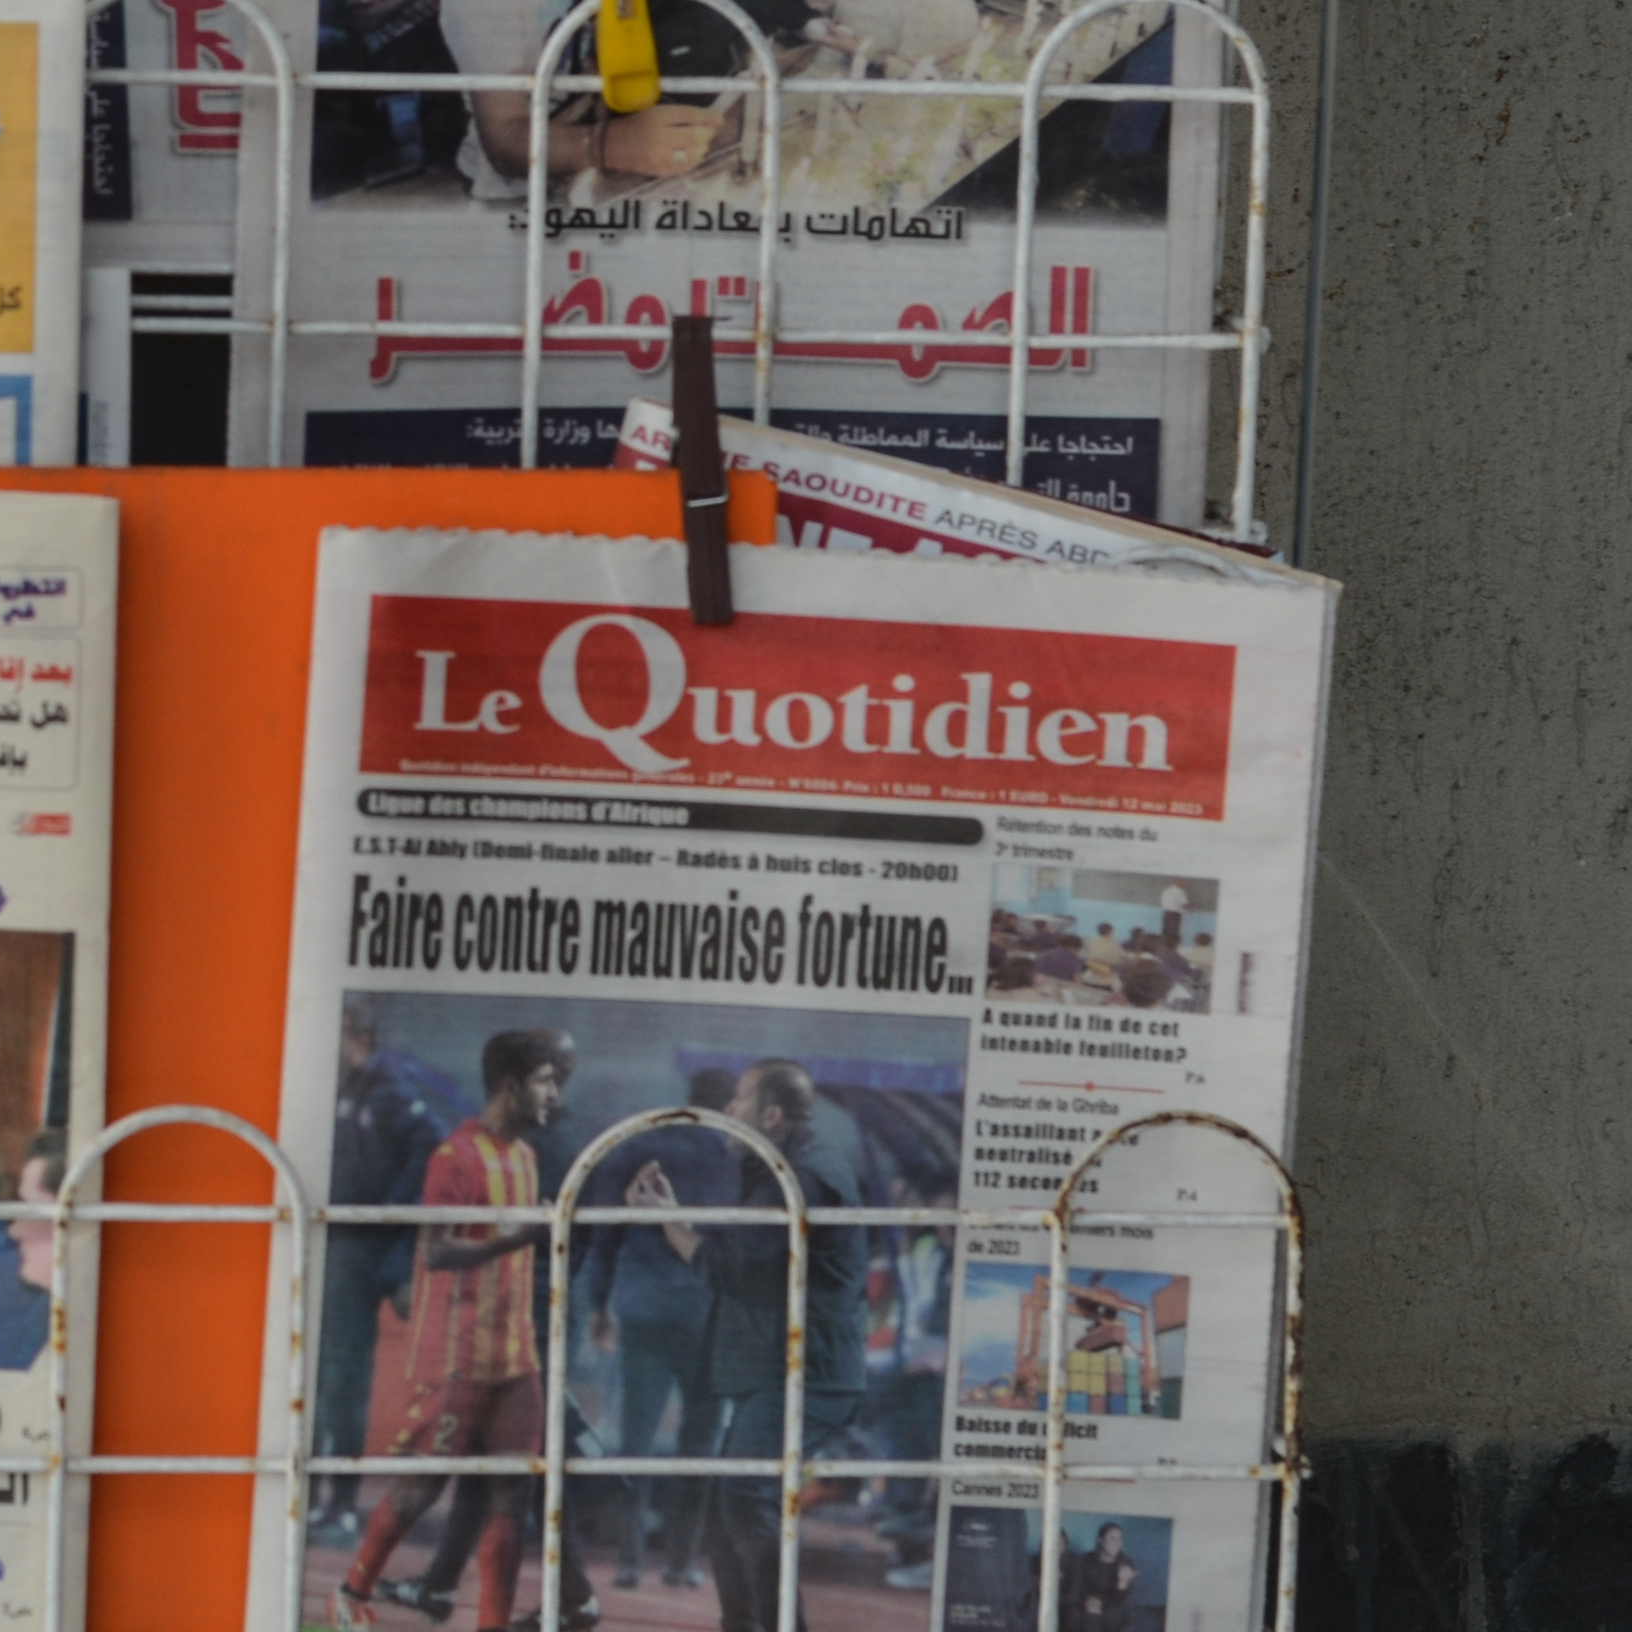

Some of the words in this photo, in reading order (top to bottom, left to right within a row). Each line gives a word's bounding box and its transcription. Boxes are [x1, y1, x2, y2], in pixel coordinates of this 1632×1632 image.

[804, 204, 966, 247] اتهامات
[762, 460, 928, 522] SAOUDITE
[934, 500, 1038, 550] APRÈS
[412, 648, 522, 734] Le
[536, 610, 1174, 774] Quotidien
[366, 790, 426, 820] Ligue
[430, 795, 466, 818] des
[469, 796, 605, 828] champions
[608, 801, 691, 829] d'Afrique
[346, 873, 443, 974] Faire
[452, 886, 583, 978] contre
[591, 888, 785, 988] mauvaise
[793, 893, 976, 998] fortune...
[972, 1173, 1002, 1192] 112
[951, 1478, 1004, 1498] Cannes
